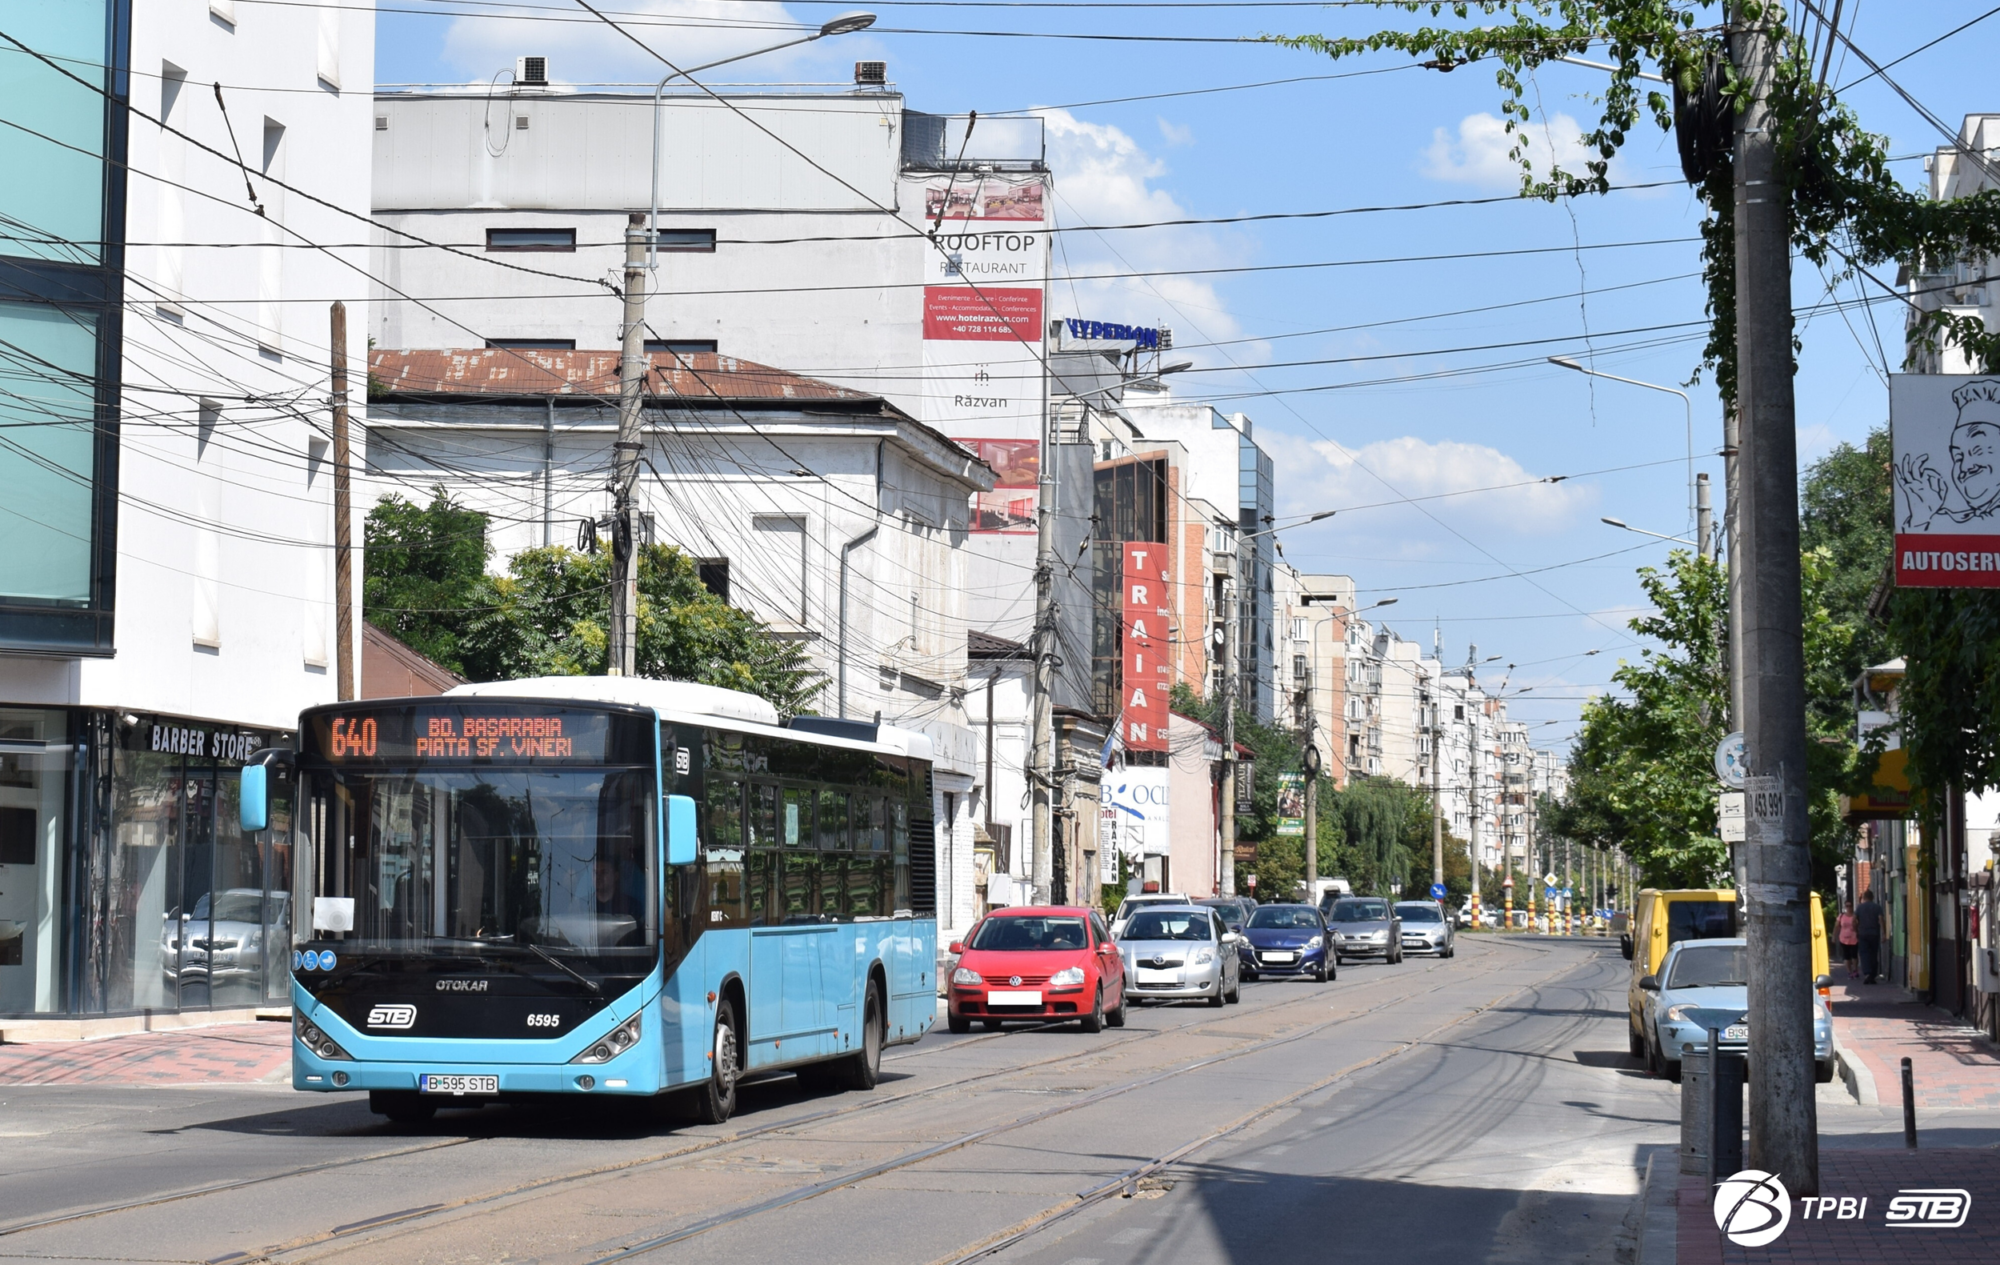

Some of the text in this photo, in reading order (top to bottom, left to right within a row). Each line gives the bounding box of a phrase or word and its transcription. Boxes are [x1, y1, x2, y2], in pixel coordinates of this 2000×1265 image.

[933, 235, 1035, 252] ROOFTOP
[939, 262, 1027, 274] RESTAURANT
[1065, 317, 1158, 349] HYPERION
[954, 394, 1008, 408] Răzvan
[1129, 551, 1148, 742] TRAIAN
[428, 718, 562, 737] BD. BASARABIA
[152, 724, 205, 757] BARBER
[211, 731, 253, 762] STORE
[331, 718, 377, 757] 640
[416, 738, 572, 757] PIATA SF. VINERI
[435, 980, 489, 991] OTOKAR
[366, 1006, 414, 1025] STB
[526, 1013, 560, 1027] 6595
[429, 1076, 496, 1091] B 595 STB
